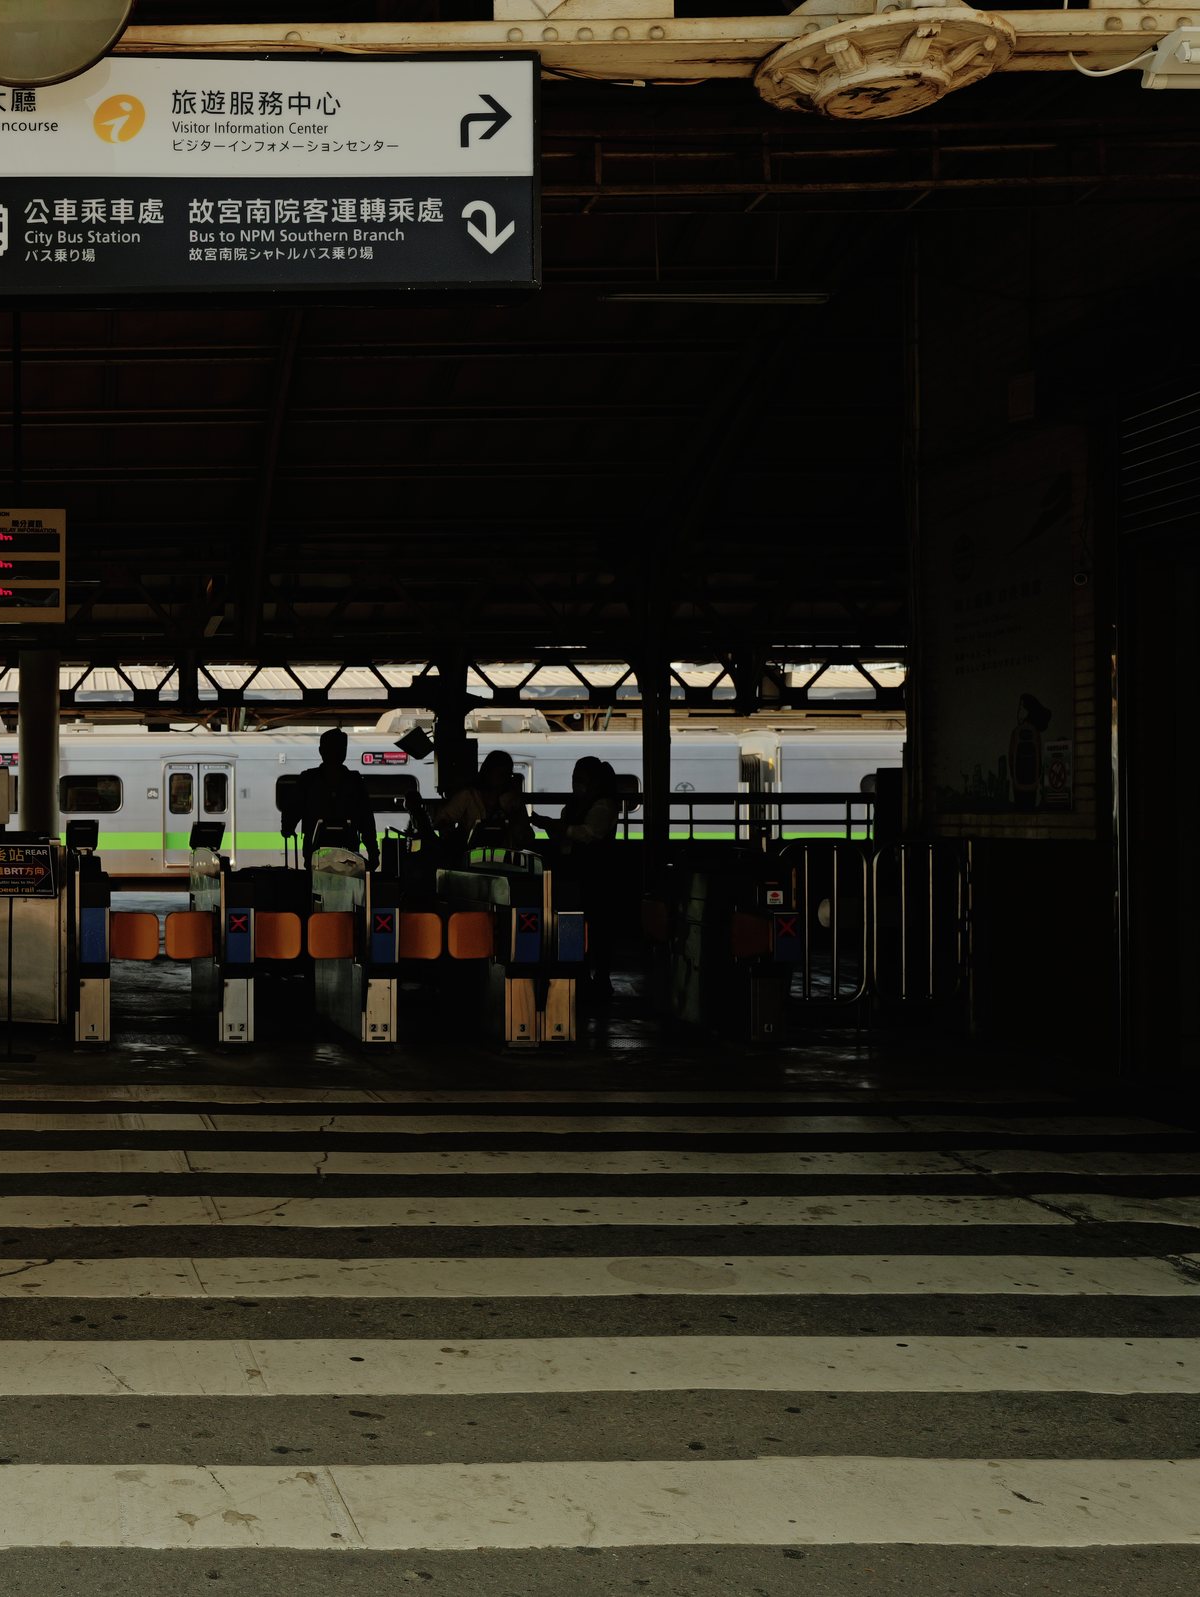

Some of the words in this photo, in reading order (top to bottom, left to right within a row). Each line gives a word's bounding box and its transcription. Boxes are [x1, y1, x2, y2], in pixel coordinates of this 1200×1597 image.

[171, 89, 341, 116] 旅遊服務中心
[171, 120, 211, 134] Visitor
[214, 120, 285, 135] Information
[288, 122, 329, 135] Center
[172, 138, 399, 153] ビジターインフォメーションセンター
[23, 197, 165, 225] 公車乘車處
[188, 197, 444, 224] 故宮南院客運轉乘處
[24, 230, 53, 247] City
[57, 230, 84, 244] Bus
[87, 229, 141, 244] Station
[189, 229, 215, 243] Bus
[218, 230, 236, 243] to
[240, 229, 275, 242] NPM
[279, 228, 348, 242] Southern
[353, 227, 405, 242] Branch
[24, 248, 96, 263] バス乗り場
[188, 246, 374, 262] 故宮南院シャトルバス乗り場
